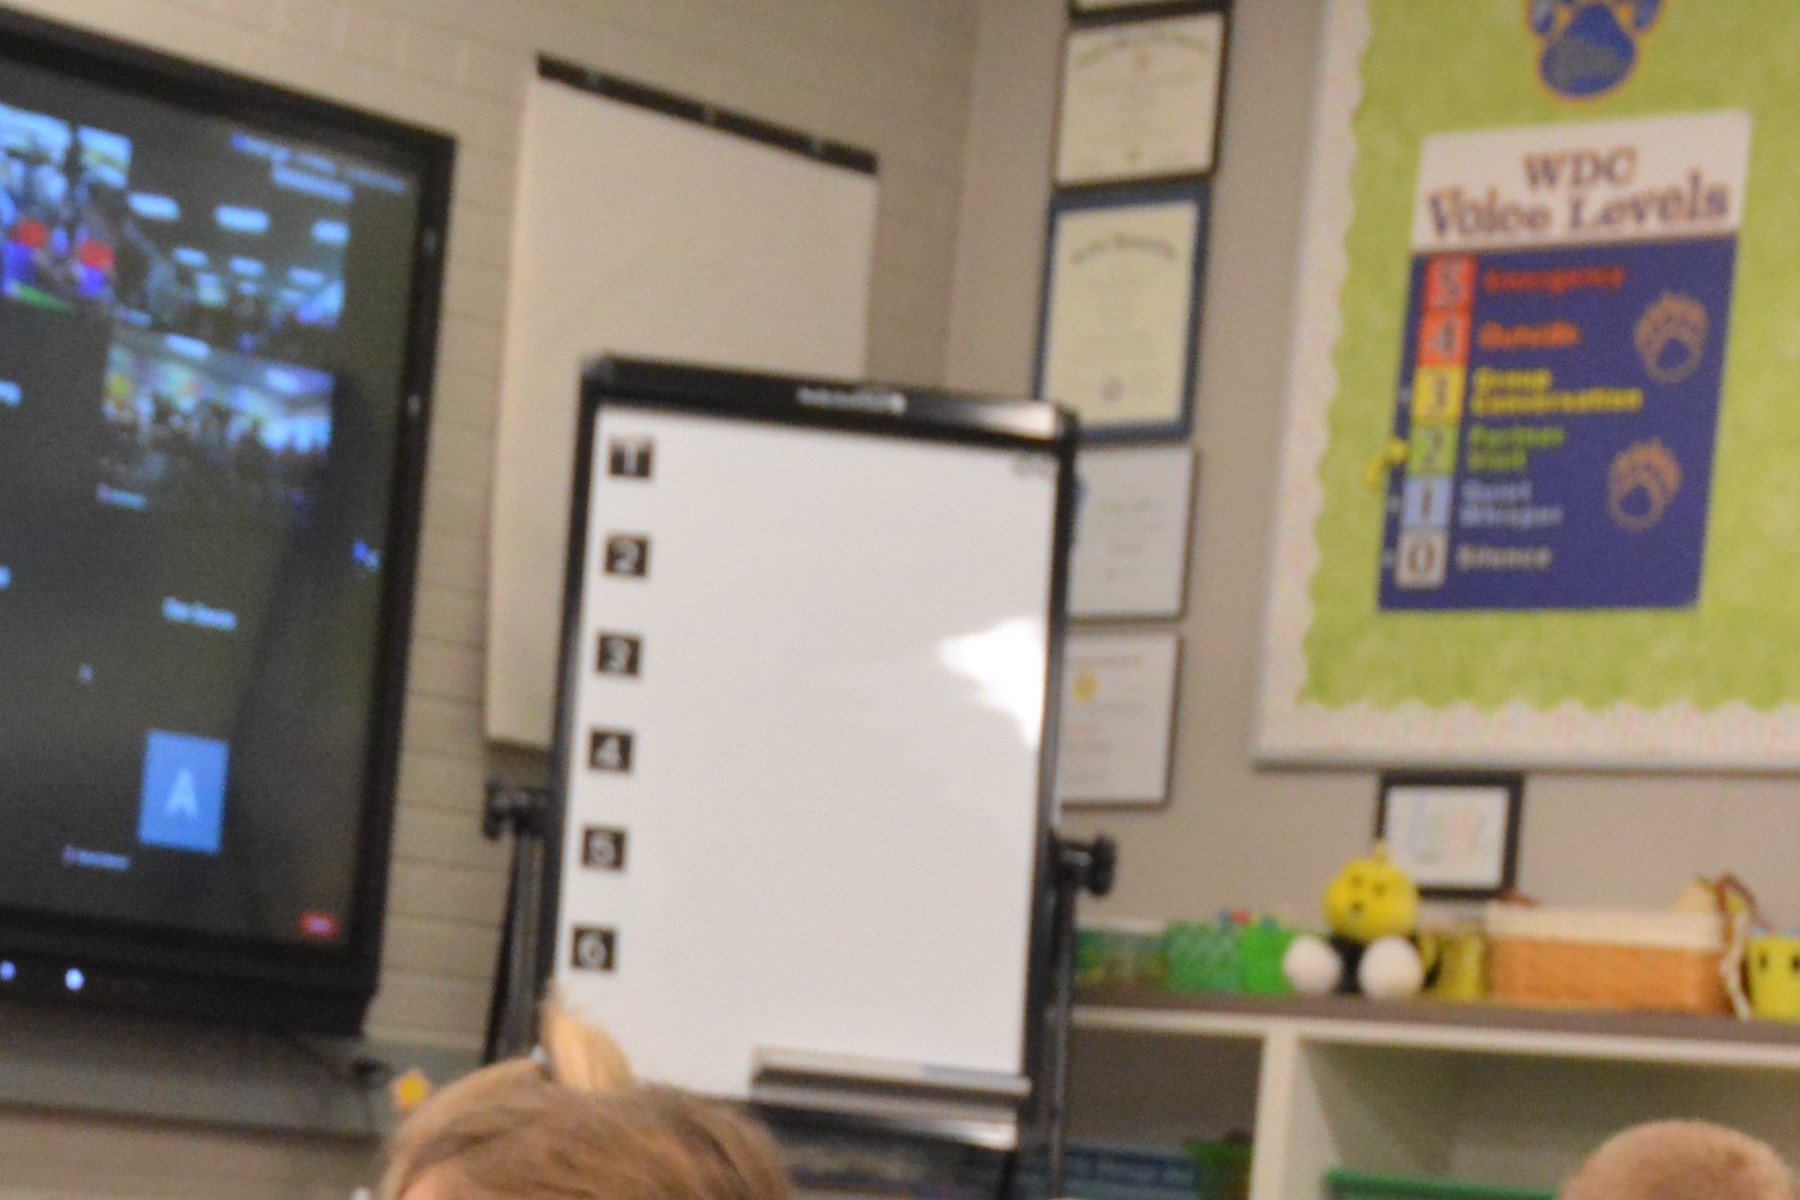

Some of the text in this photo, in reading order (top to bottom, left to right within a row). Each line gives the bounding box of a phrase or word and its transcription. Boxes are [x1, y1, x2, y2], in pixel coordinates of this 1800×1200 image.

[1523, 146, 1639, 191] WDC
[1427, 167, 1729, 235] Voice Levels
[1407, 542, 1436, 575] 0
[163, 767, 200, 820] A
